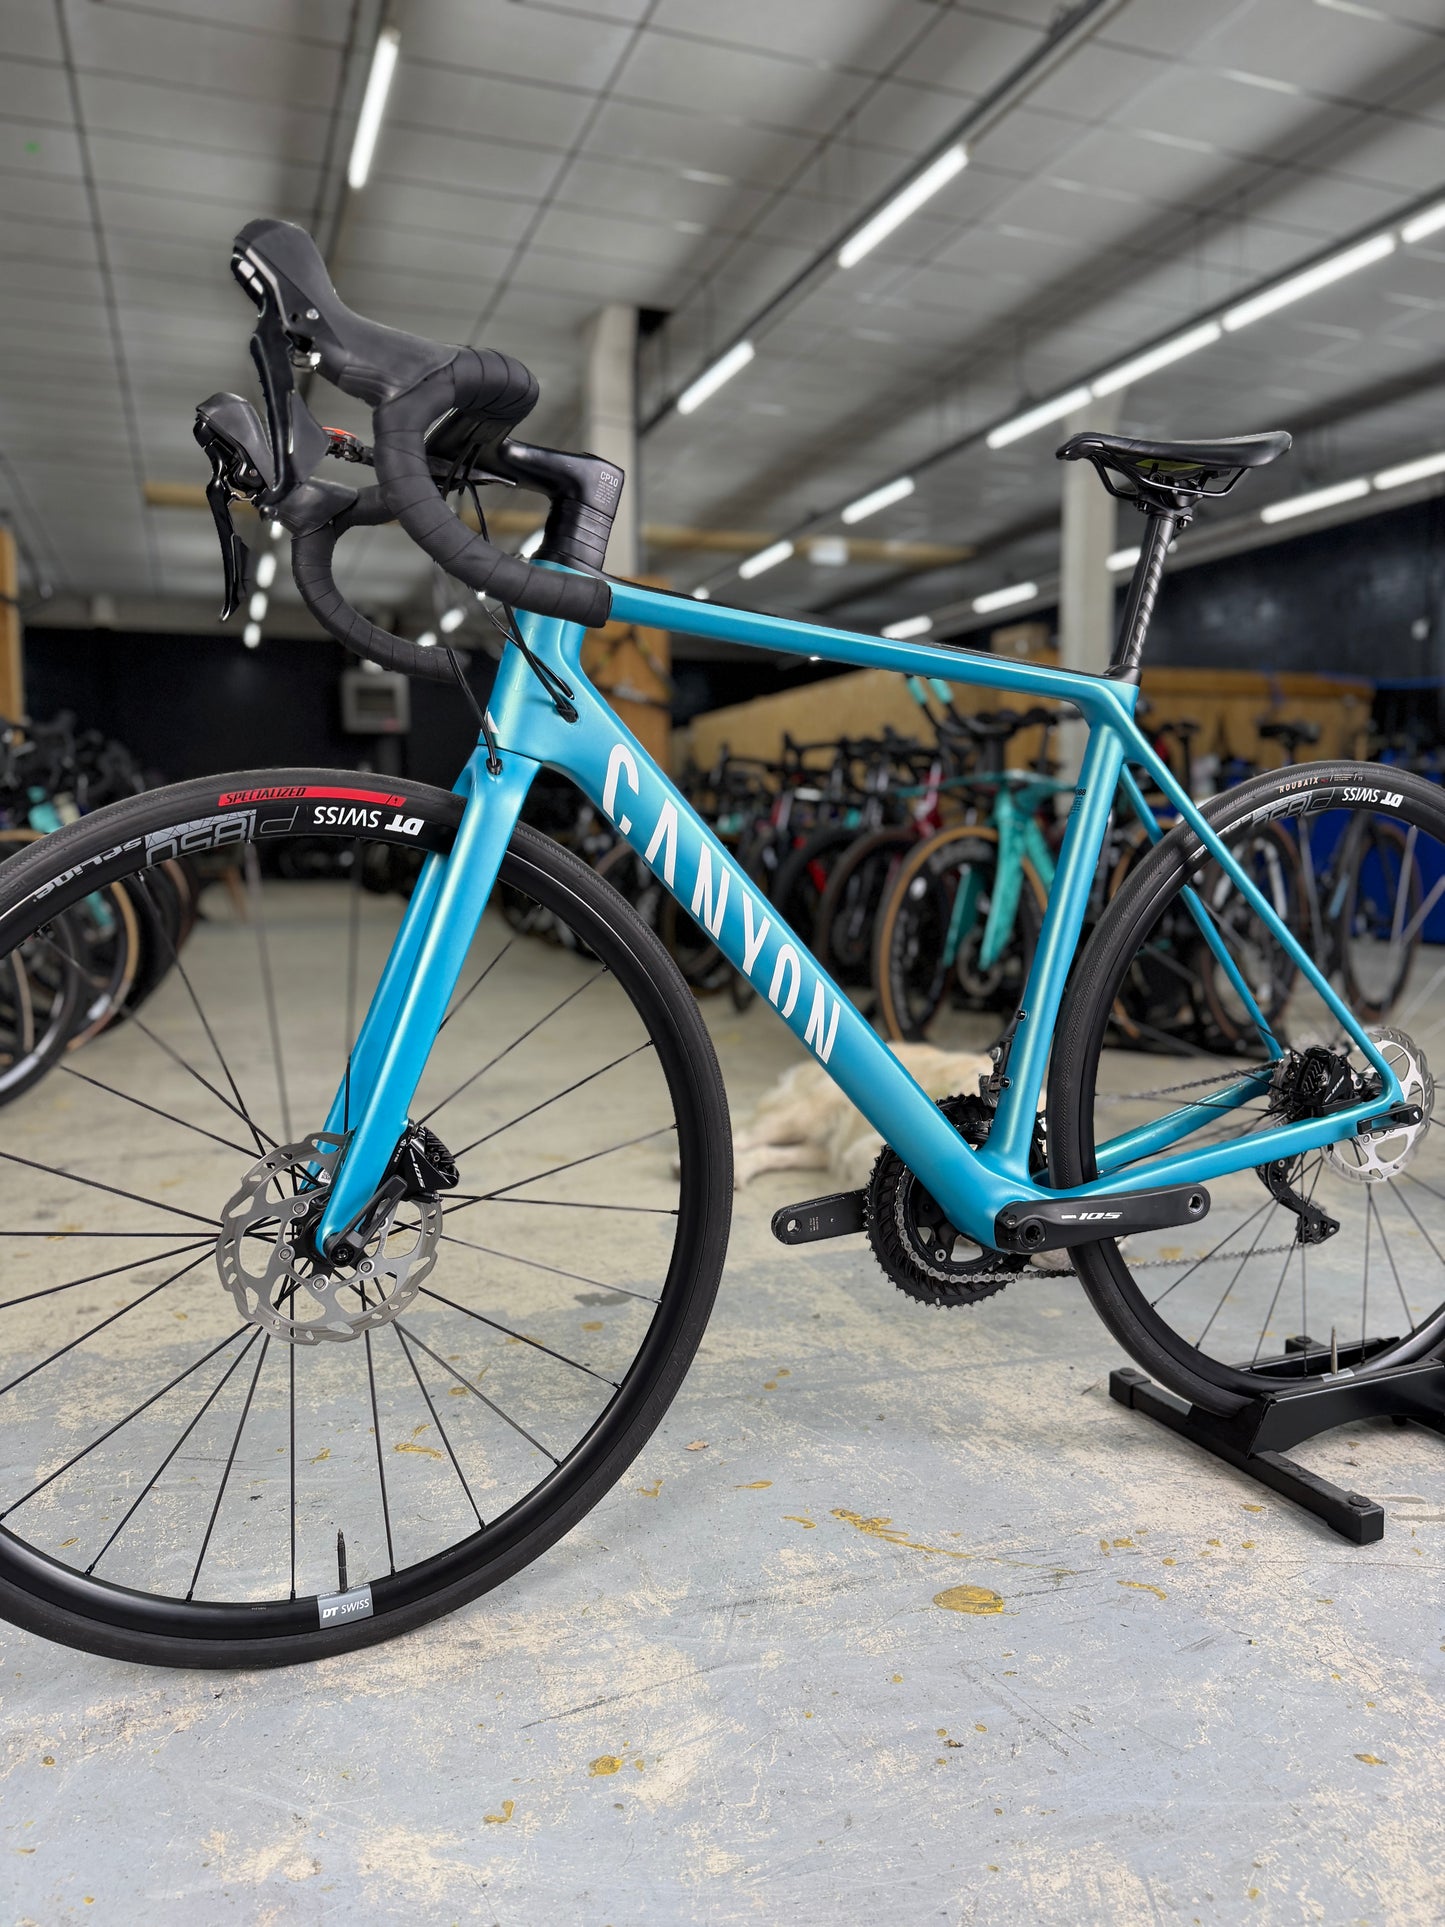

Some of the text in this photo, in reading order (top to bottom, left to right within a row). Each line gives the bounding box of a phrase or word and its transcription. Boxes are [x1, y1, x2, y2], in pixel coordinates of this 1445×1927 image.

[600, 471, 619, 487] CP10
[1279, 776, 1320, 793] ROUBAIX
[226, 787, 306, 804] SPECIALIZED
[1341, 787, 1404, 808] DT SWISS
[313, 806, 425, 836] DT SWISS
[602, 743, 841, 1065] CANYON
[1078, 1211, 1123, 1221] 105
[322, 1598, 370, 1619] DT SWISS
